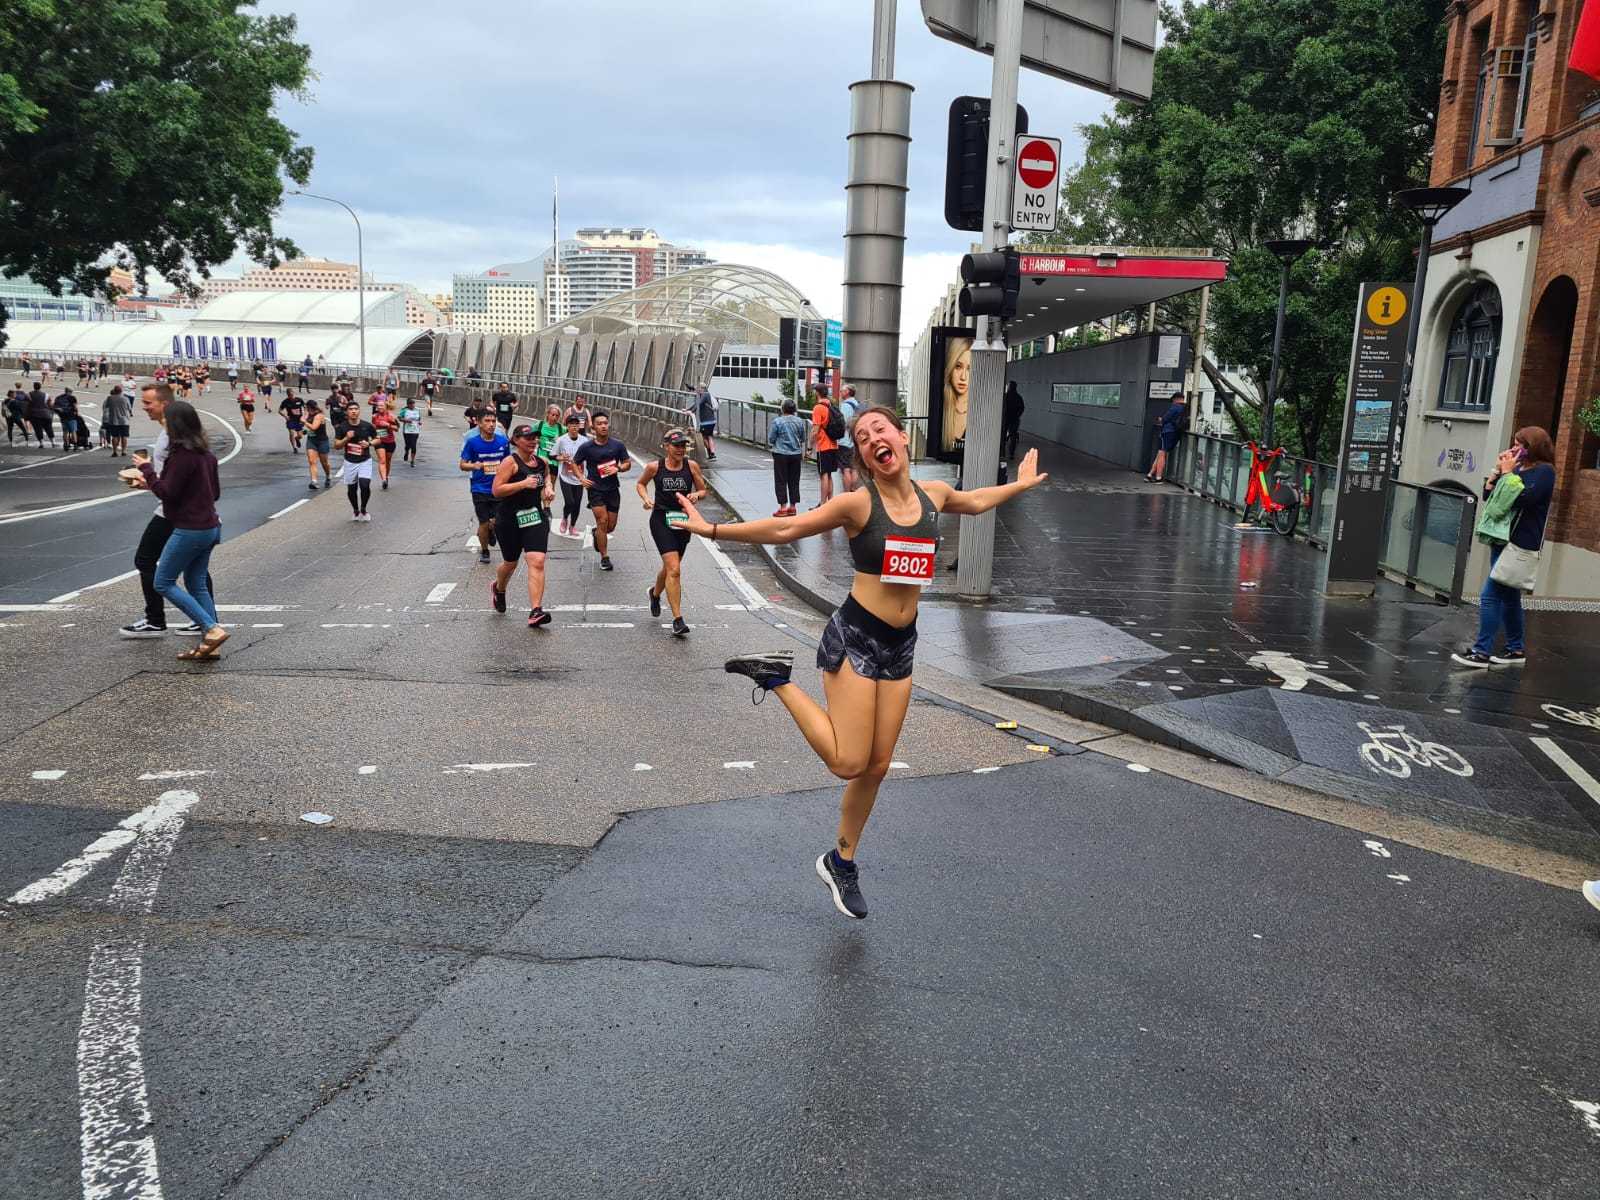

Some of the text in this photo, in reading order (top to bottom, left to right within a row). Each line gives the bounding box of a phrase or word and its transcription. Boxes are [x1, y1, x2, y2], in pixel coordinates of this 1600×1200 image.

[1025, 193, 1045, 208] NO
[1016, 211, 1051, 224] ENTRY
[1028, 258, 1066, 272] HARBOUR
[173, 335, 277, 363] AQUARIUM
[889, 555, 928, 575] 9802
